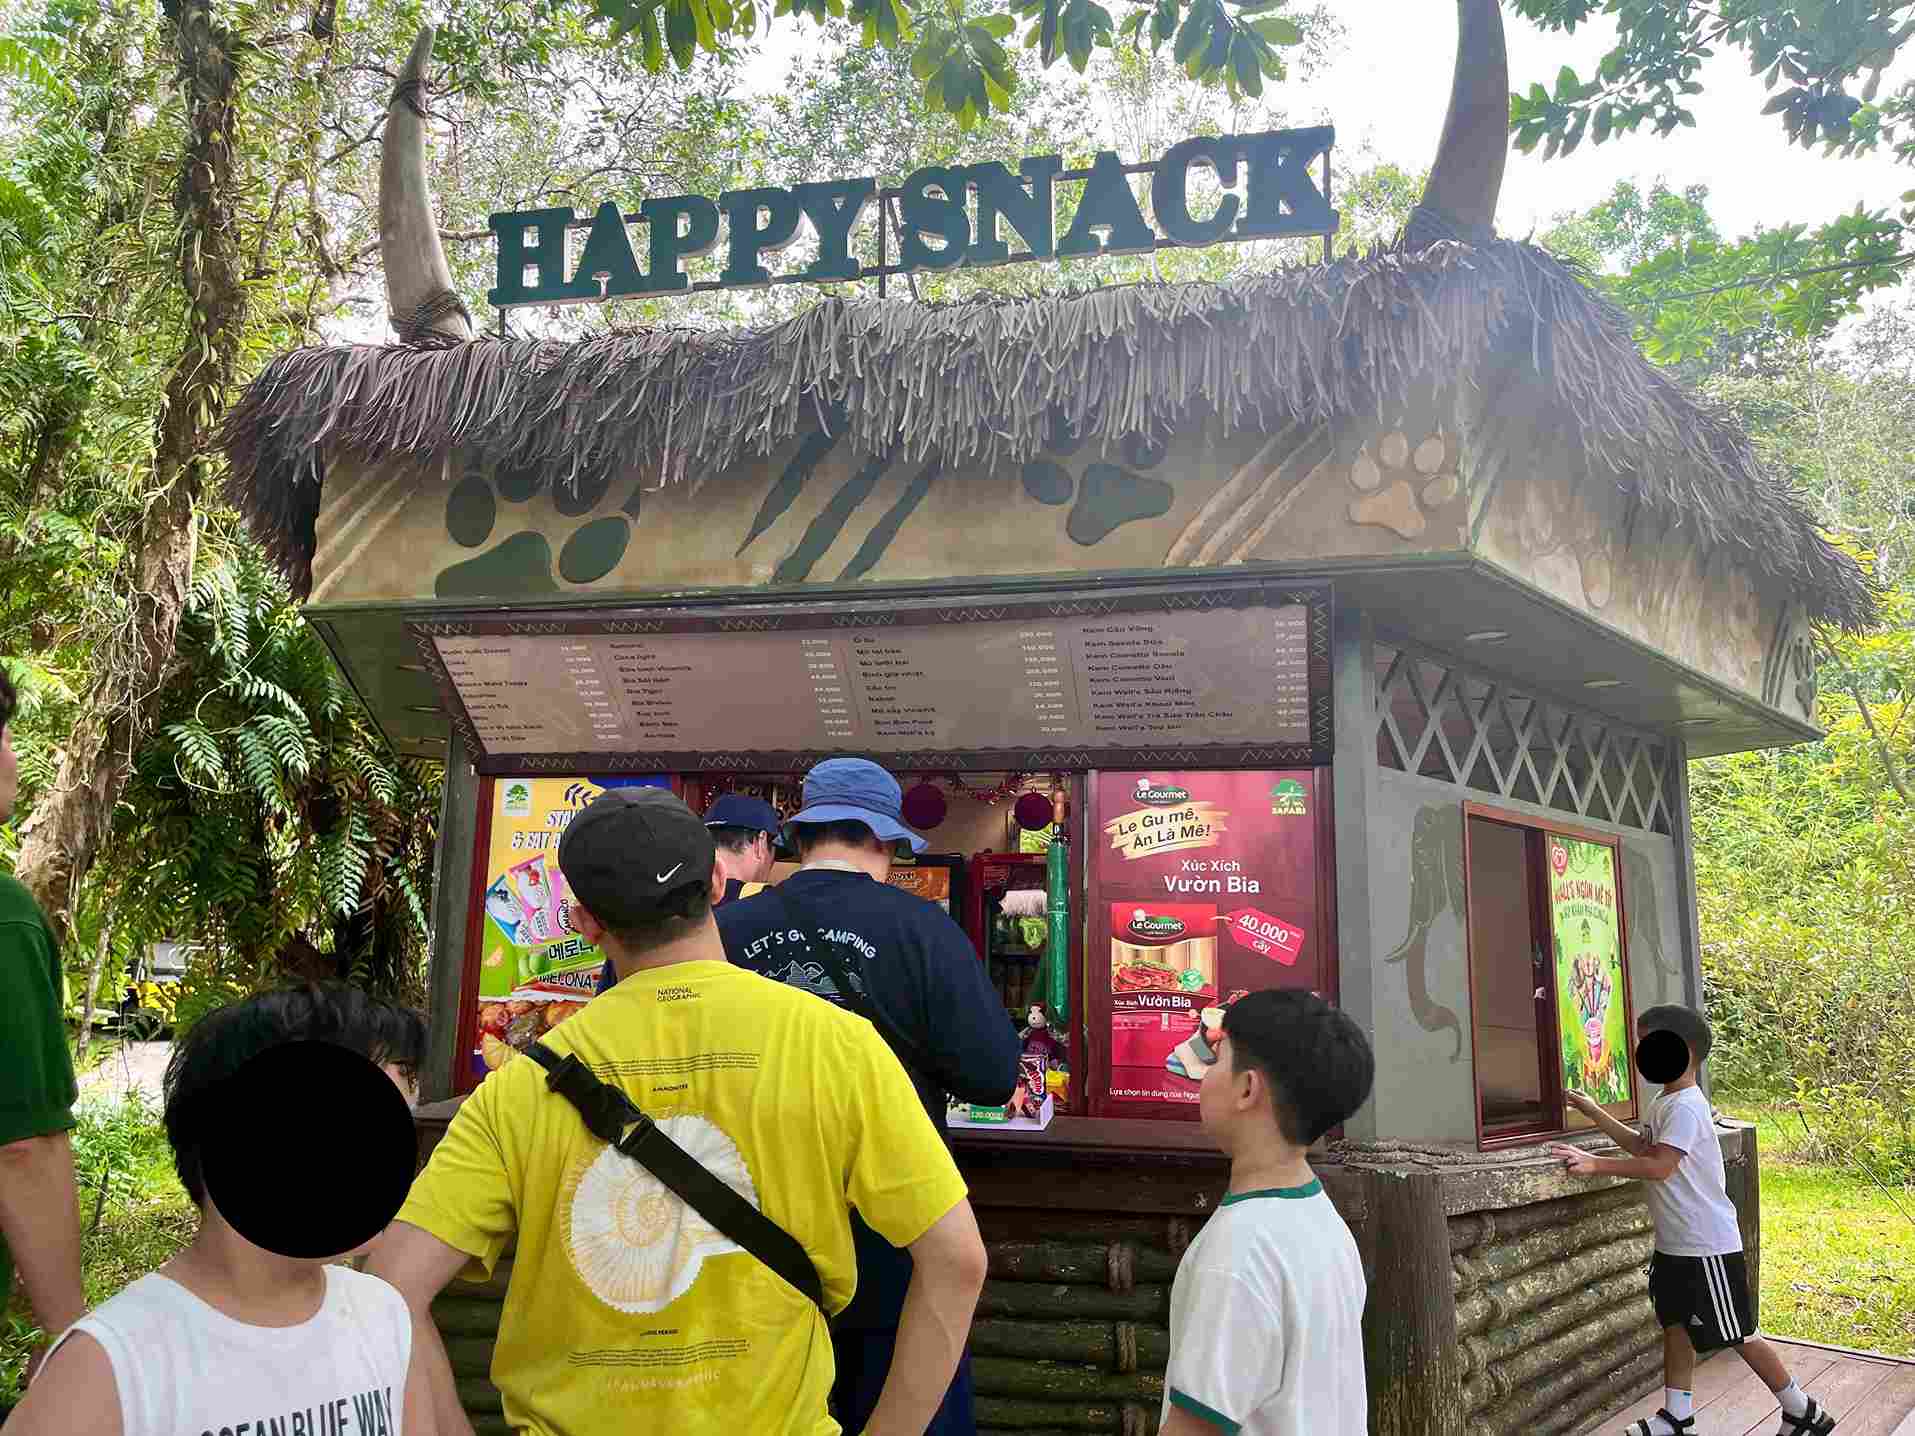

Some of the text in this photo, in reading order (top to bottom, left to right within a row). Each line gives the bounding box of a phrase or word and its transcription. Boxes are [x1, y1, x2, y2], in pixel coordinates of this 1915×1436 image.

[488, 126, 1339, 307] HAPPY SNACK
[1119, 822, 1137, 836] Le
[1142, 815, 1164, 828] Gu
[1157, 828, 1175, 843] Là
[1180, 823, 1211, 839] Mê!
[1181, 858, 1241, 872] Xúc Xích
[1164, 875, 1260, 894] Vườn Bia
[1239, 914, 1289, 943] 40.000
[743, 930, 785, 959] LET'S
[1138, 994, 1171, 1008] Vườn
[1171, 995, 1192, 1008] Bia
